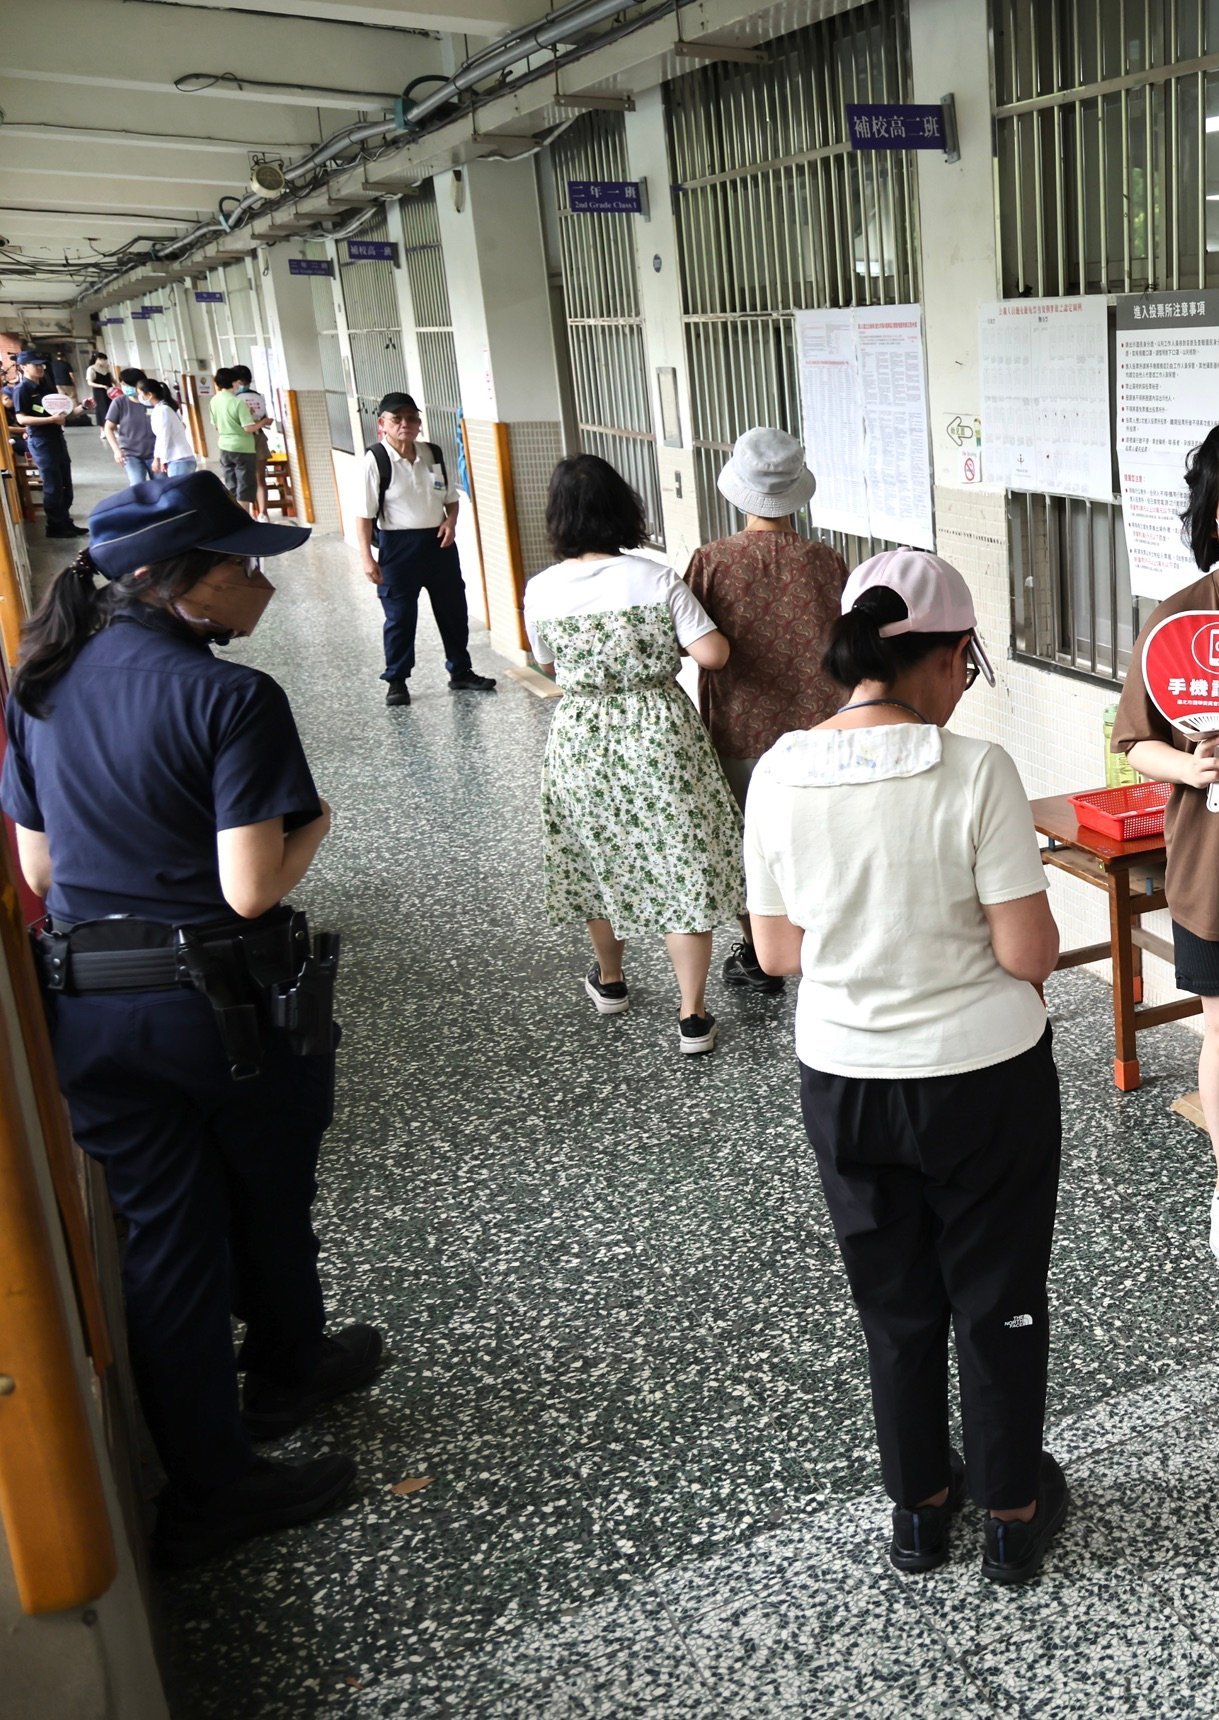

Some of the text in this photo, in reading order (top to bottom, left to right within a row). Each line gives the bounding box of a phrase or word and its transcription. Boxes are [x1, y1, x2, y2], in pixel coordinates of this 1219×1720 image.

[853, 115, 940, 138] 補校高二班
[572, 185, 637, 198] 二年一班
[589, 201, 612, 209] Grade
[613, 201, 632, 209] Class
[1133, 301, 1206, 319] 進入投票所注意事項
